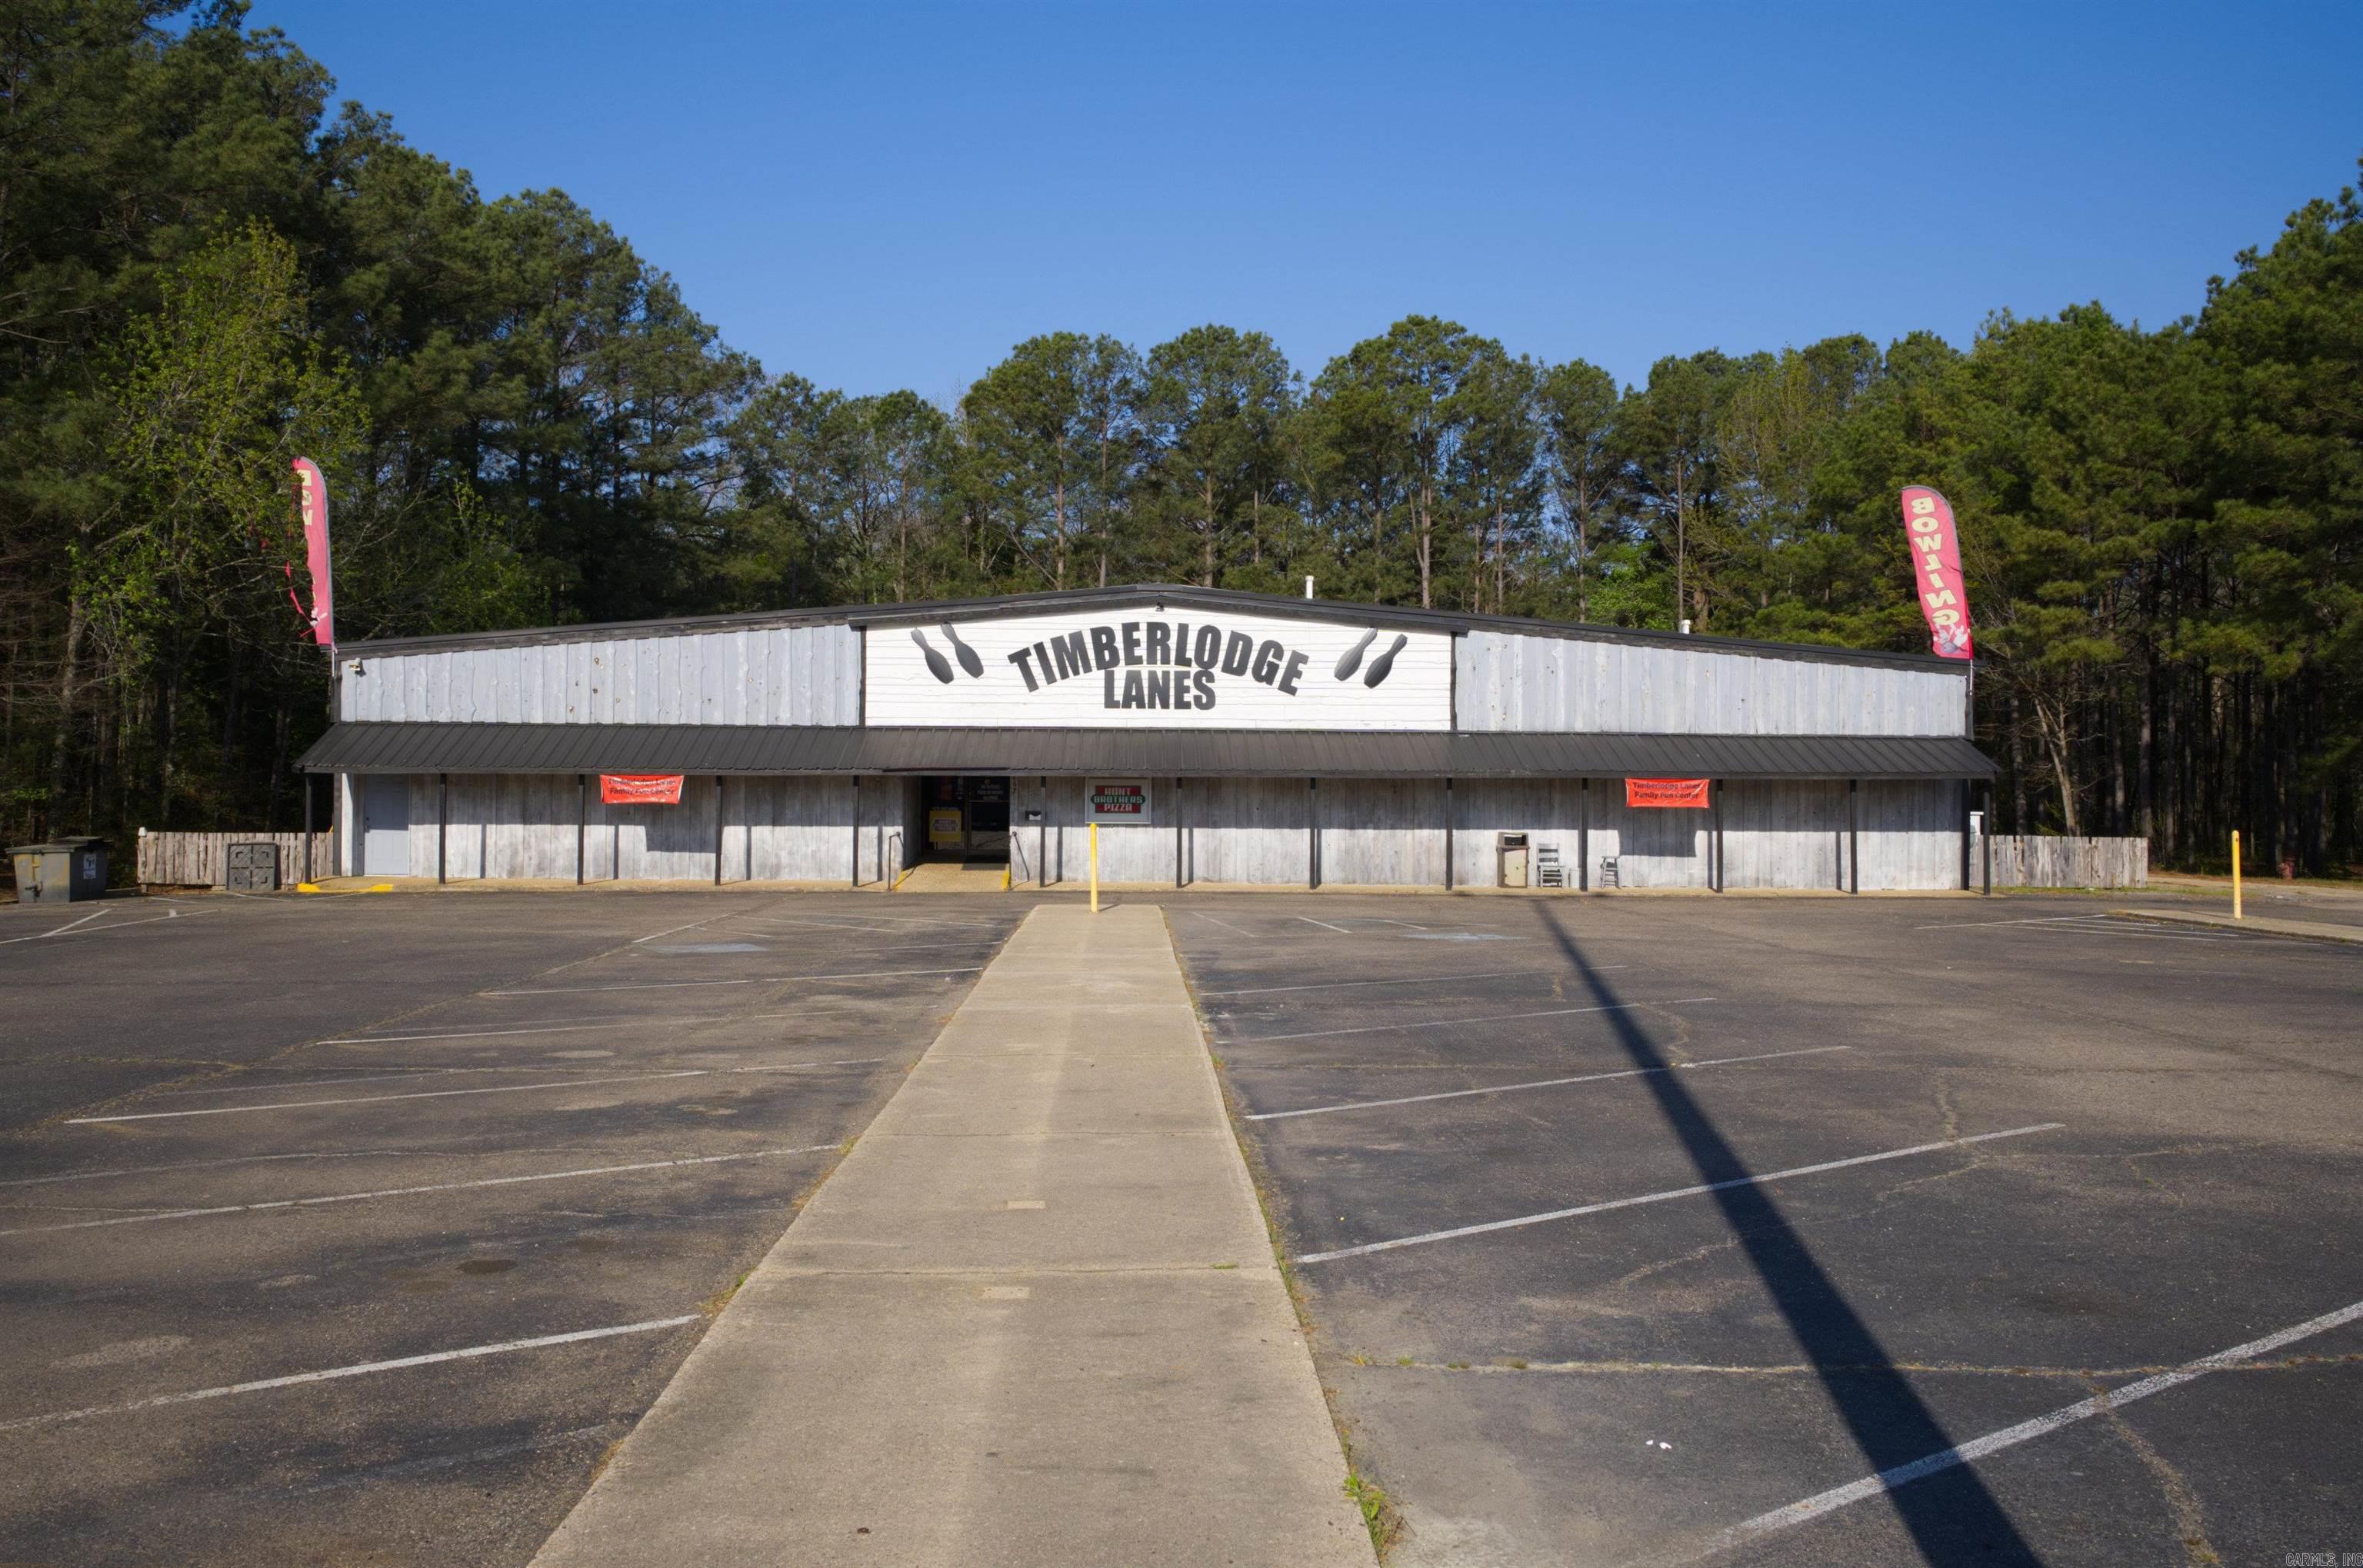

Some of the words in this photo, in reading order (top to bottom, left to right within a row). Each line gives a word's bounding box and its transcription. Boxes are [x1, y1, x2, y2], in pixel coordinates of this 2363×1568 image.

[1008, 621, 1308, 696] TIMBERLODGE
[1104, 670, 1215, 710] LANES
[1104, 787, 1132, 795] HUNT
[1093, 795, 1143, 804] BROTHERS
[1104, 804, 1132, 812] PIZZA
